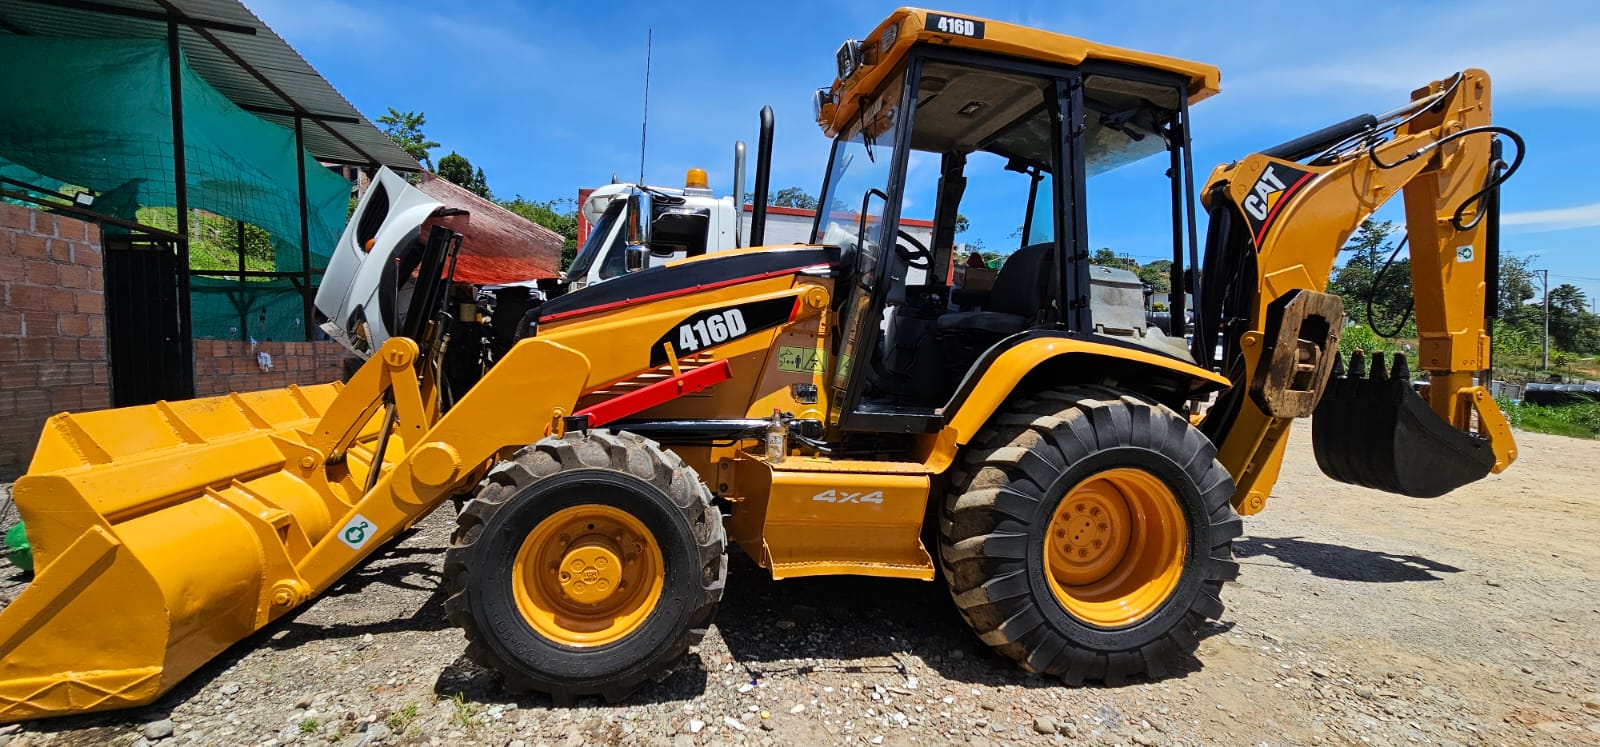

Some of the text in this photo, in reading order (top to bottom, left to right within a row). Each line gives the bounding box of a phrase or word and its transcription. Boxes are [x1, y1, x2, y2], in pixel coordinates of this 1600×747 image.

[937, 16, 975, 36] 416D
[1244, 166, 1287, 221] CAT
[679, 308, 747, 351] 416D
